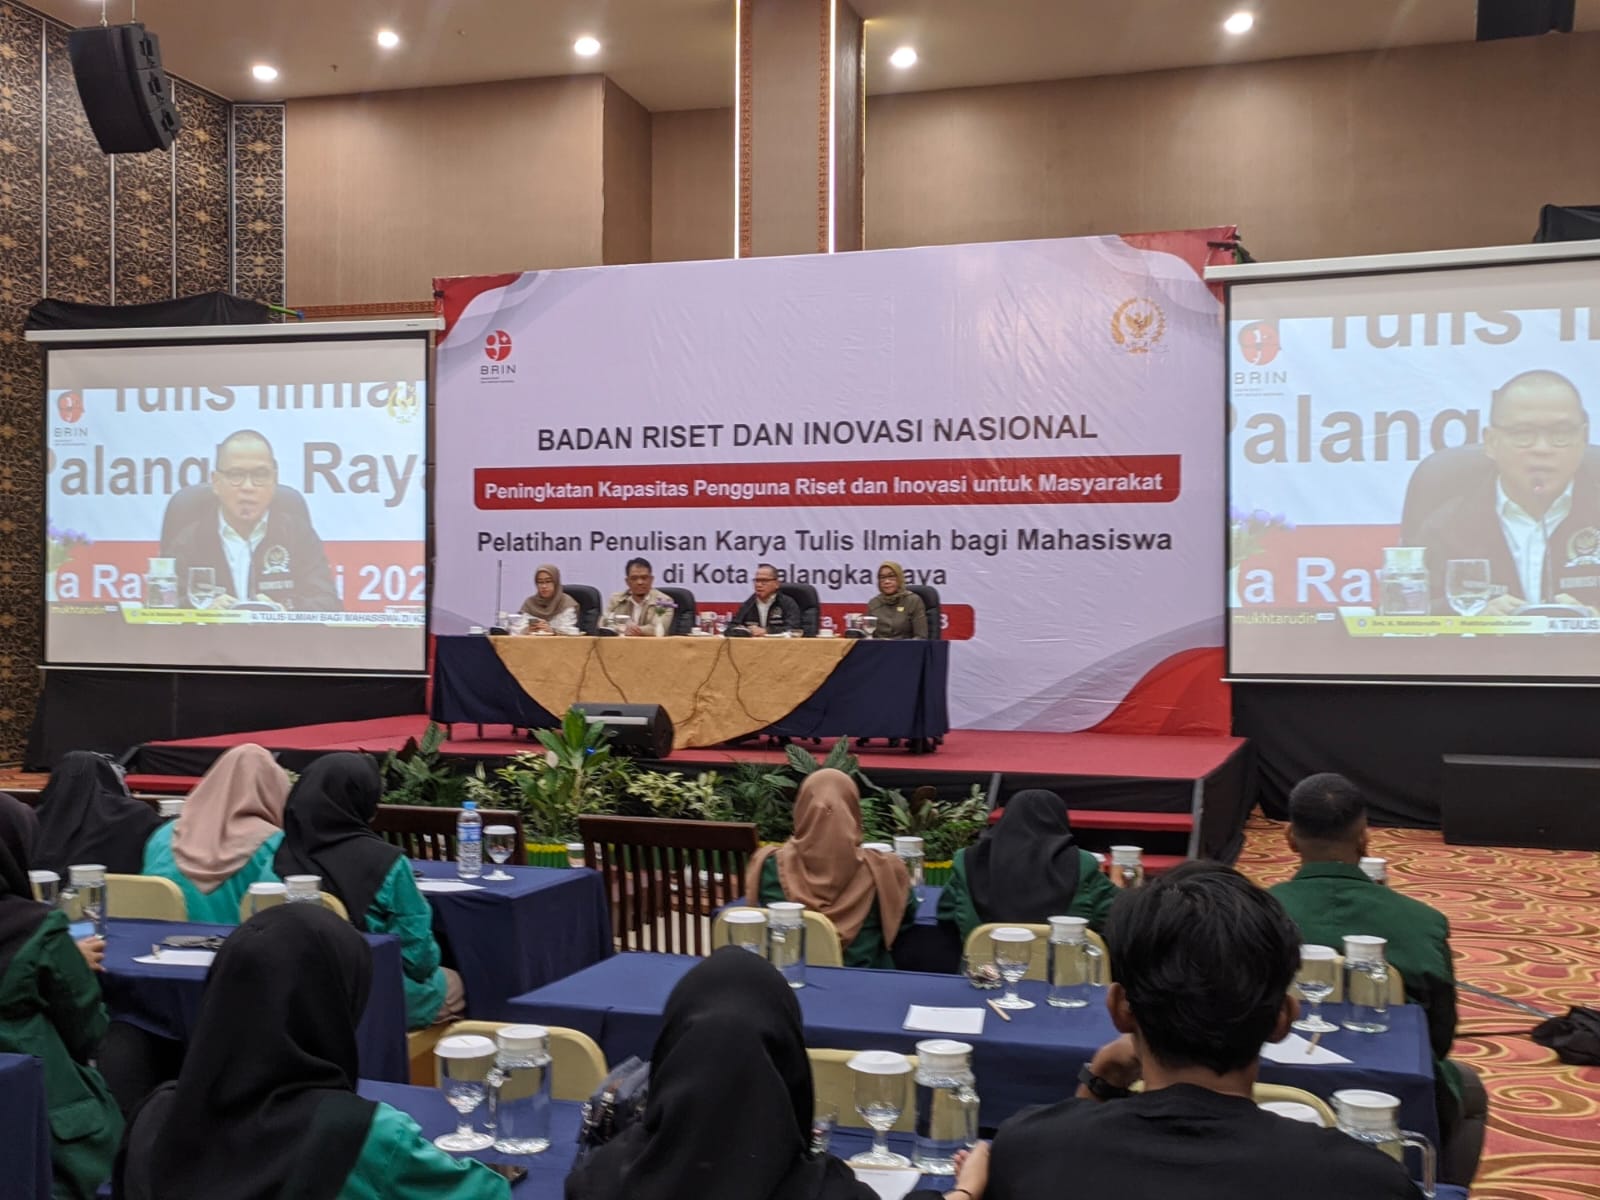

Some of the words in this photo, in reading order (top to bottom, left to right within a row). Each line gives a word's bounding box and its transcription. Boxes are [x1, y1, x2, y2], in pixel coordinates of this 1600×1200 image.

[480, 364, 516, 375] BRIN
[1234, 371, 1287, 385] BRIN
[54, 427, 88, 438] BRIN
[538, 427, 632, 451] BADAN
[643, 424, 724, 449] RISET
[734, 422, 793, 447] DAN
[804, 418, 922, 445] INOVASI
[934, 414, 1098, 442] NASIONAL
[303, 441, 425, 508] Ray
[484, 482, 593, 502] Peningkatan
[598, 480, 689, 501] Kapasitas
[694, 479, 789, 499] Pengguna
[796, 478, 846, 496] Riset
[851, 478, 888, 495] dan
[894, 475, 967, 494] Inovasi
[973, 474, 1032, 492] untuk
[1040, 473, 1163, 496] Masyarakat
[478, 531, 582, 552] Pelatihan
[591, 531, 707, 552] Penulisan
[717, 530, 786, 556] Karya
[796, 530, 854, 551] Tulis
[864, 530, 941, 551] Ilmiah
[952, 529, 1007, 556] bagi
[1018, 528, 1172, 551] Mahasiswa
[664, 565, 684, 583] di
[693, 564, 748, 584] Kota
[777, 563, 873, 590] alangka
[905, 569, 947, 586] aya
